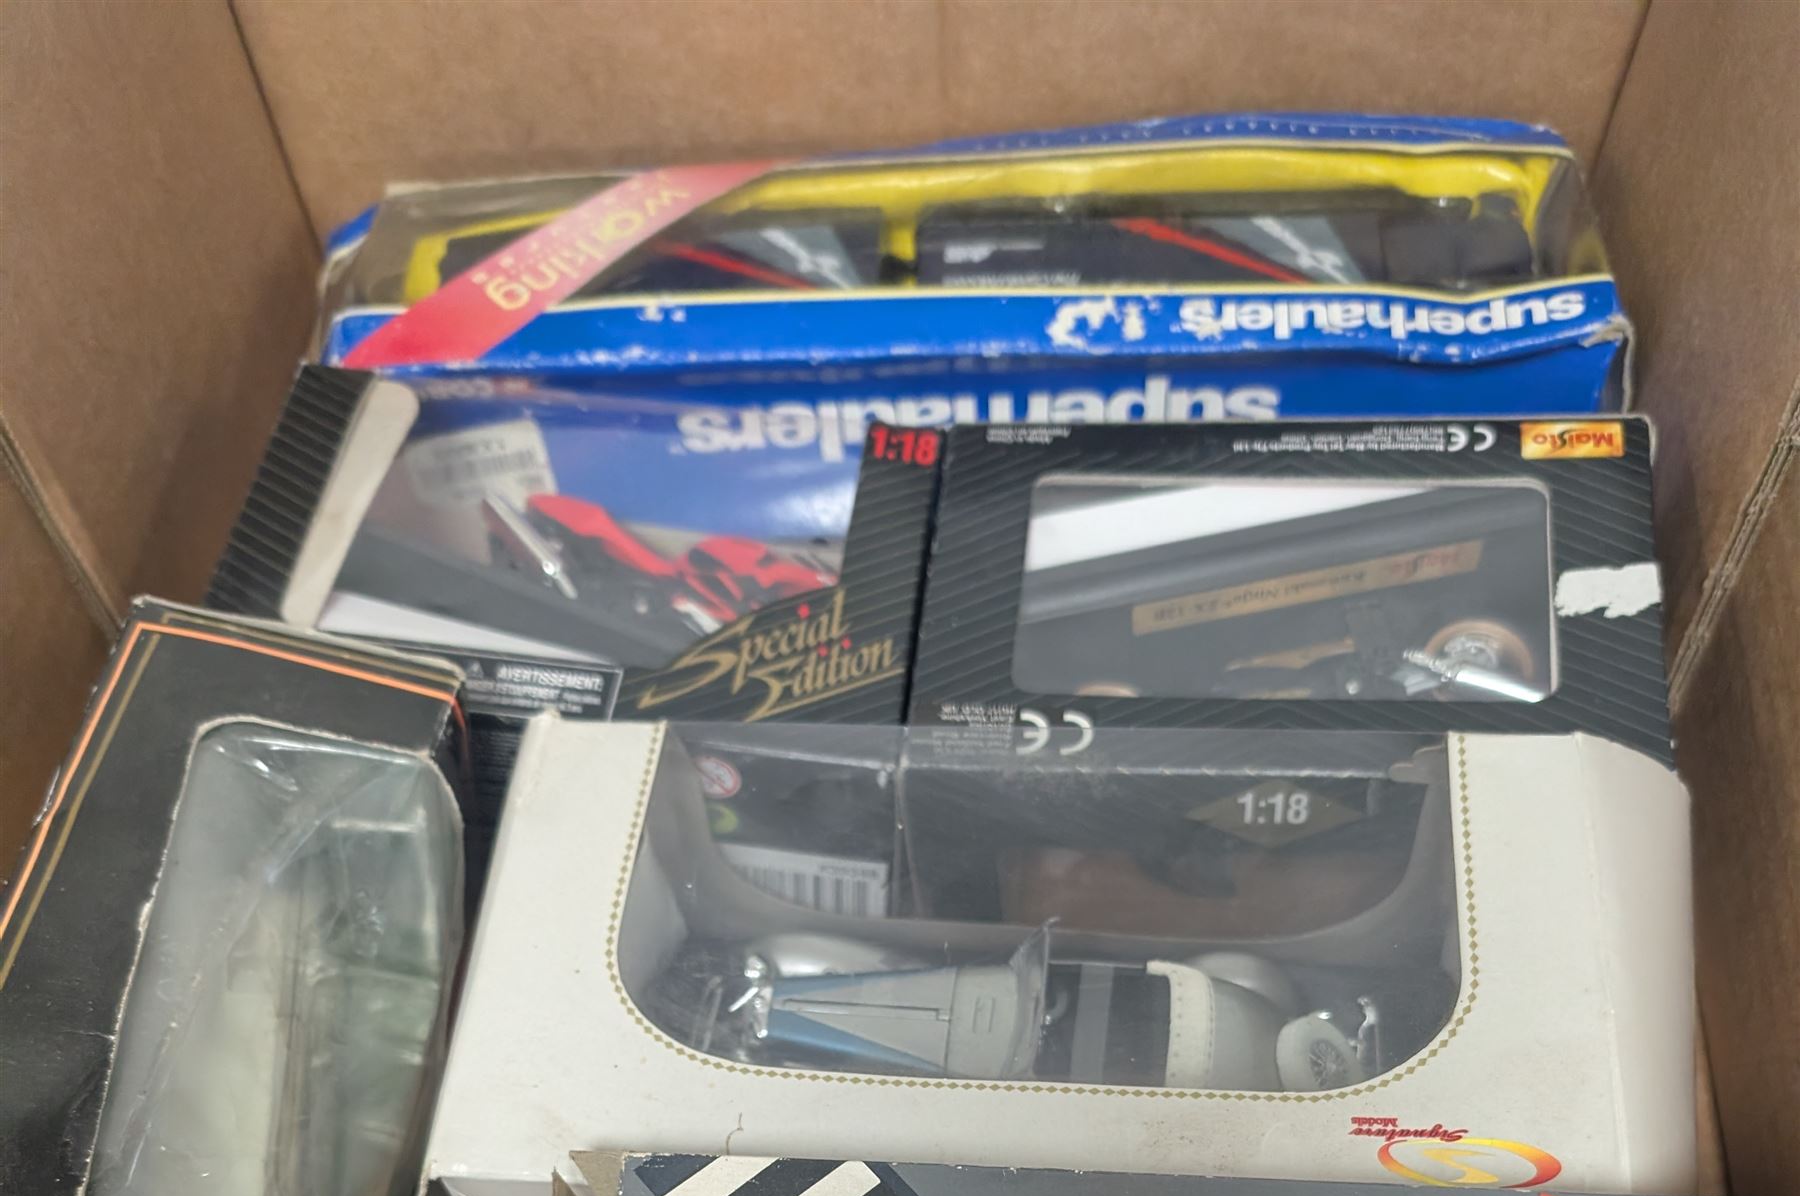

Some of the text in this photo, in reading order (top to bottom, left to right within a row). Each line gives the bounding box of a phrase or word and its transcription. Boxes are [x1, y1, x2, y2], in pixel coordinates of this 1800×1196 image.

[1179, 292, 1586, 340] superhaulers
[870, 424, 940, 468] 1:18
[1532, 429, 1614, 452] Maisto
[637, 585, 850, 710] Special
[745, 635, 905, 723] Edition
[1237, 792, 1310, 826] 1:18
[1347, 1123, 1469, 1143] Signature
[1350, 1116, 1399, 1128] Models
